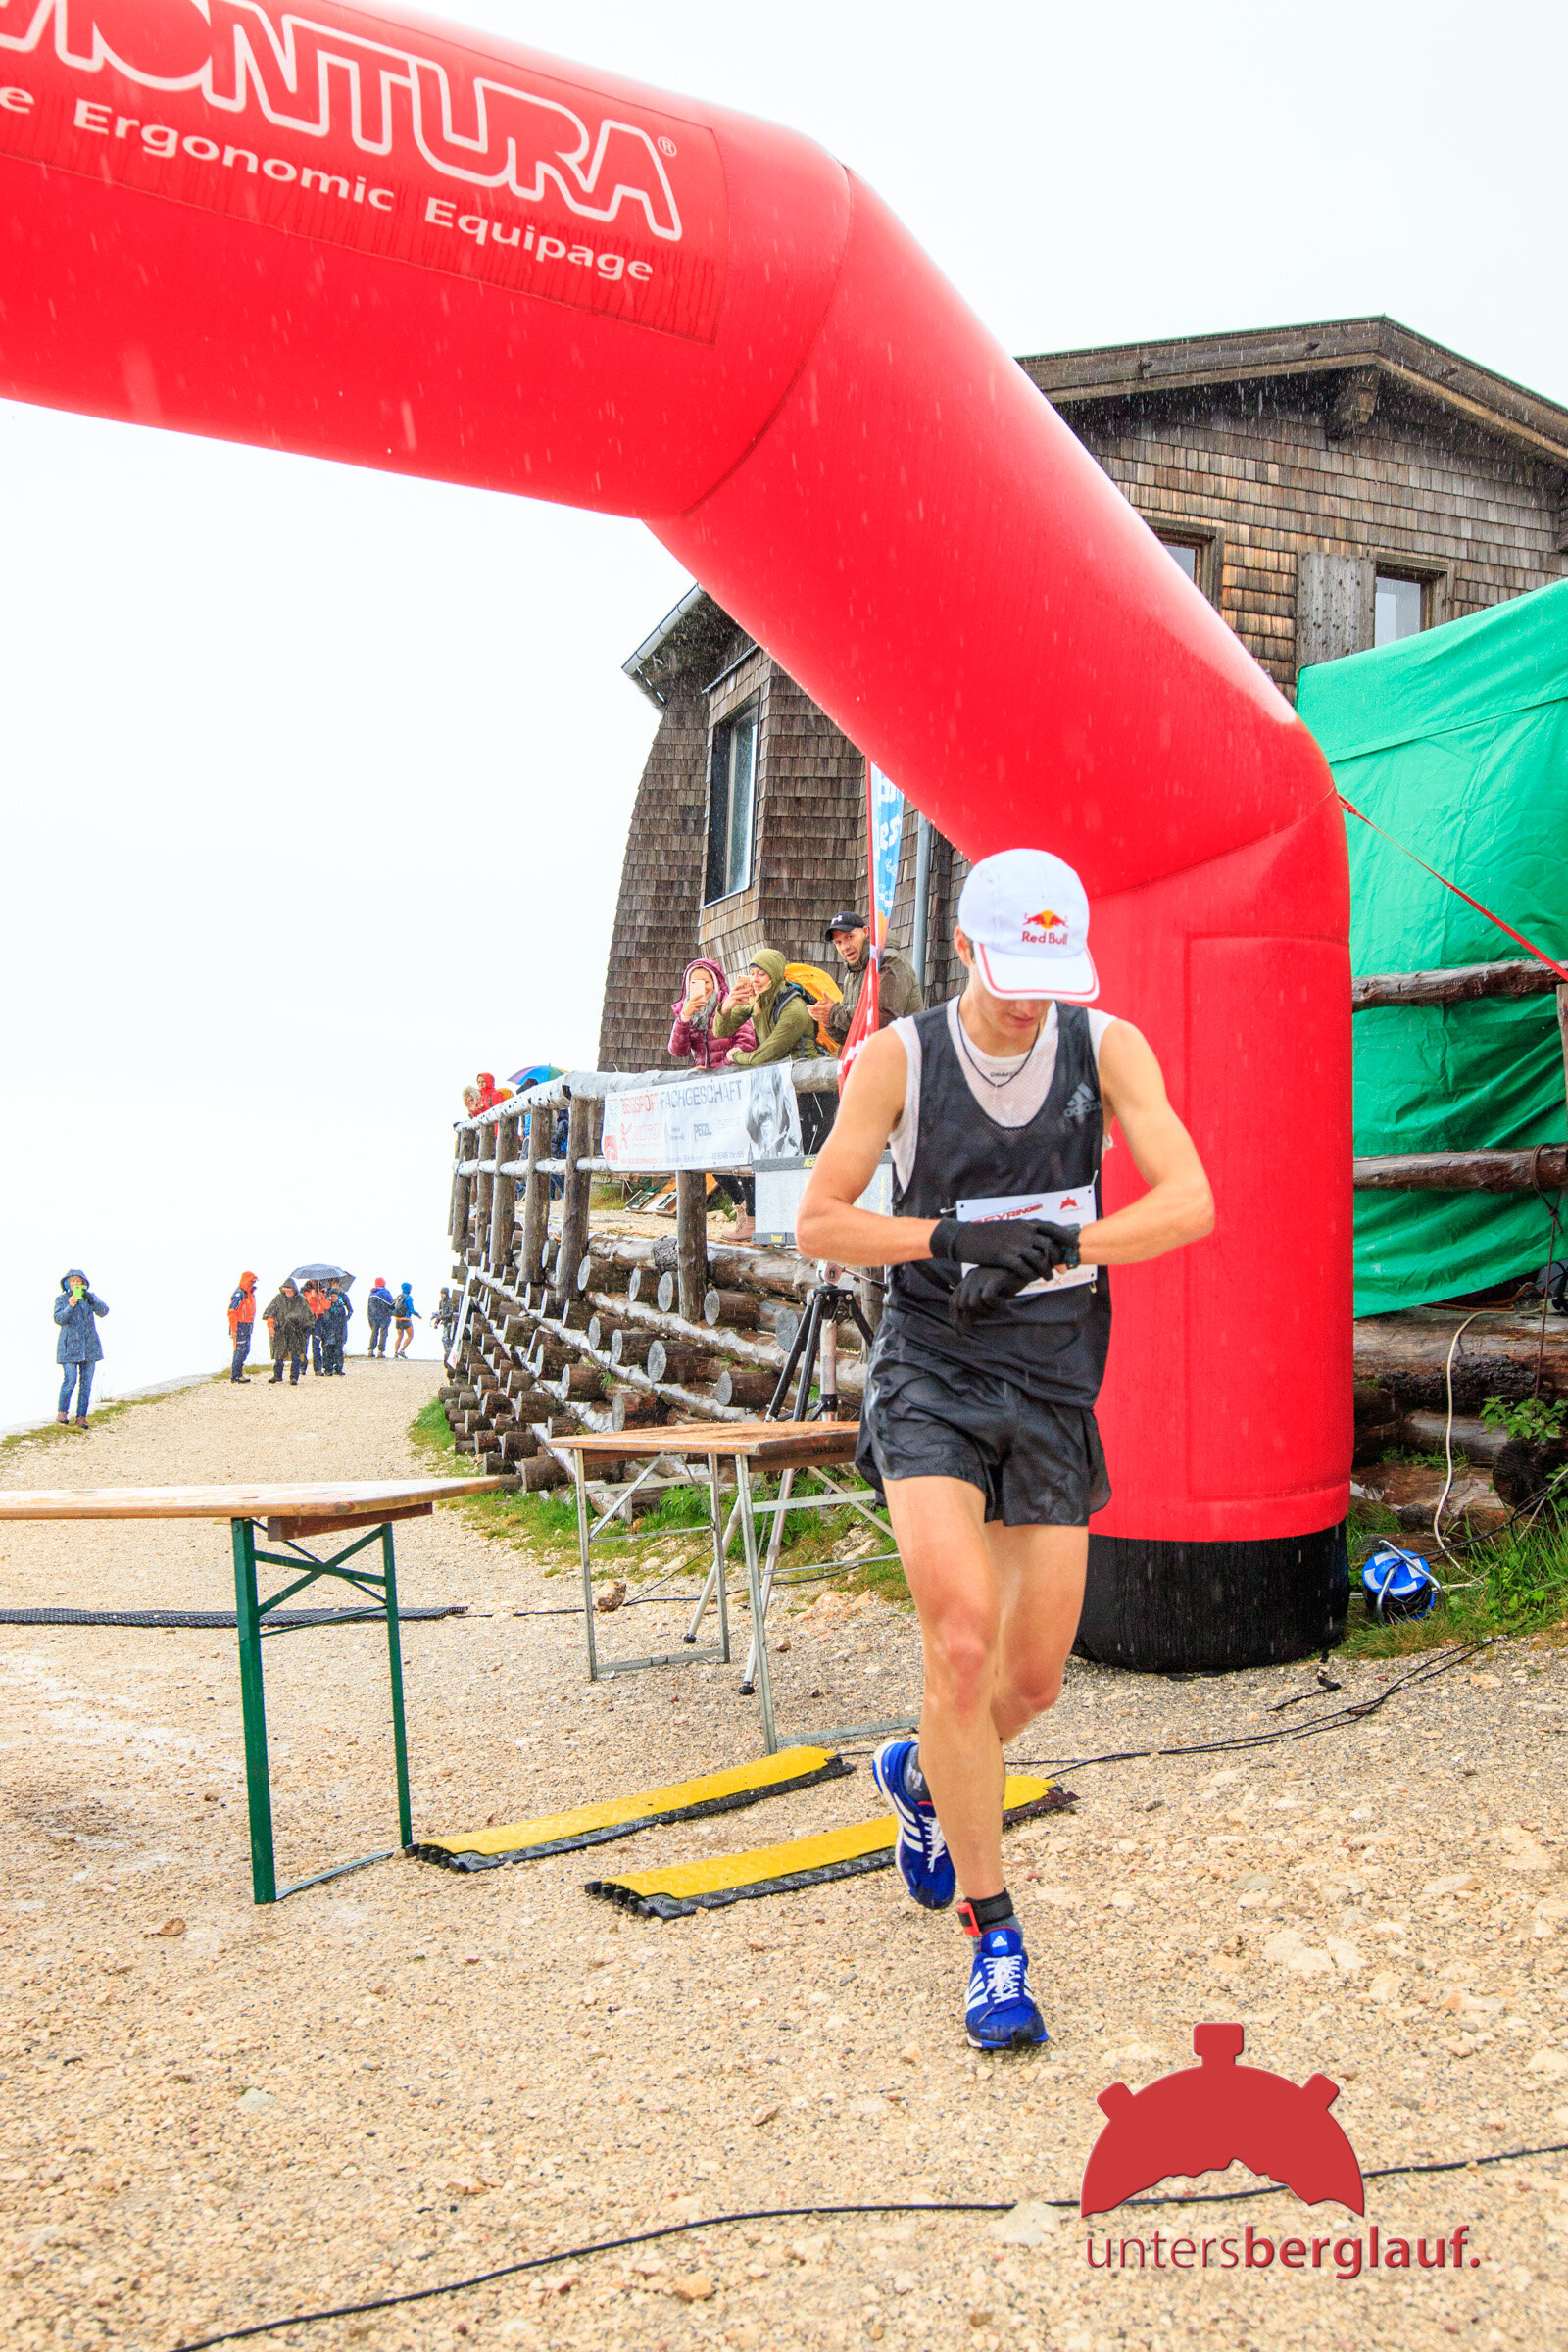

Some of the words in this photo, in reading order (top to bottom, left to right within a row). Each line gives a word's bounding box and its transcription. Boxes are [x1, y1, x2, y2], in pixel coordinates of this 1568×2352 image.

[74, 98, 395, 212] Ergonomic
[424, 200, 654, 281] Equipage
[1022, 931, 1046, 945] Red
[1049, 933, 1068, 945] Bull
